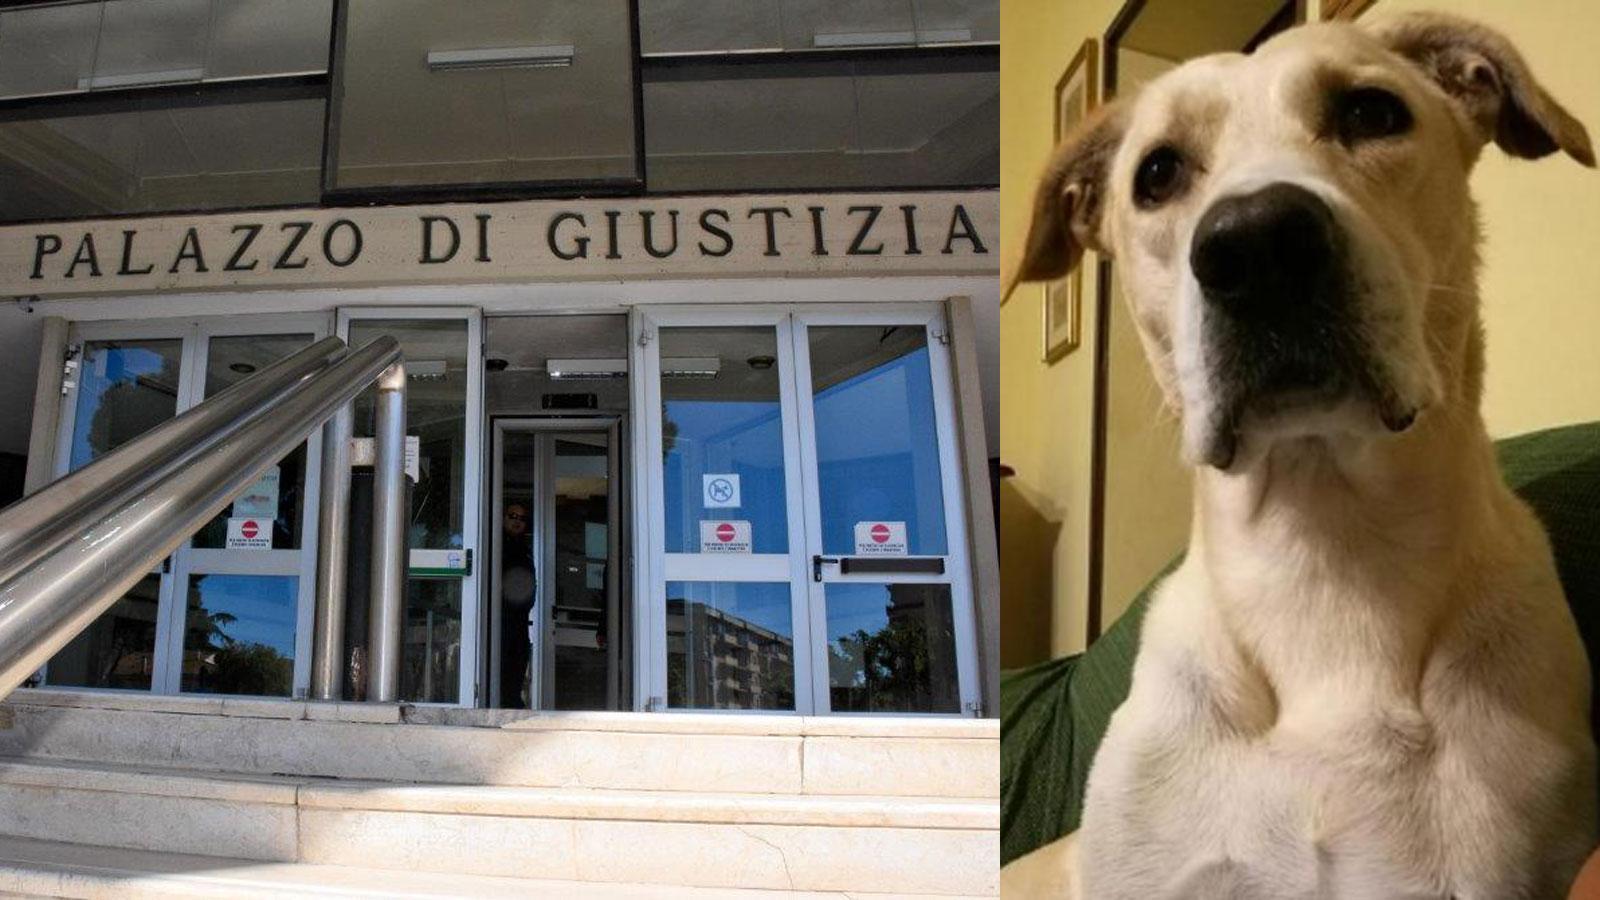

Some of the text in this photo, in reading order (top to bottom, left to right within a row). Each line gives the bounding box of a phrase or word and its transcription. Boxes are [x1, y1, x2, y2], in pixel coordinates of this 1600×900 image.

[30, 204, 989, 279] PALAZZO DI GIUSTIZIA
